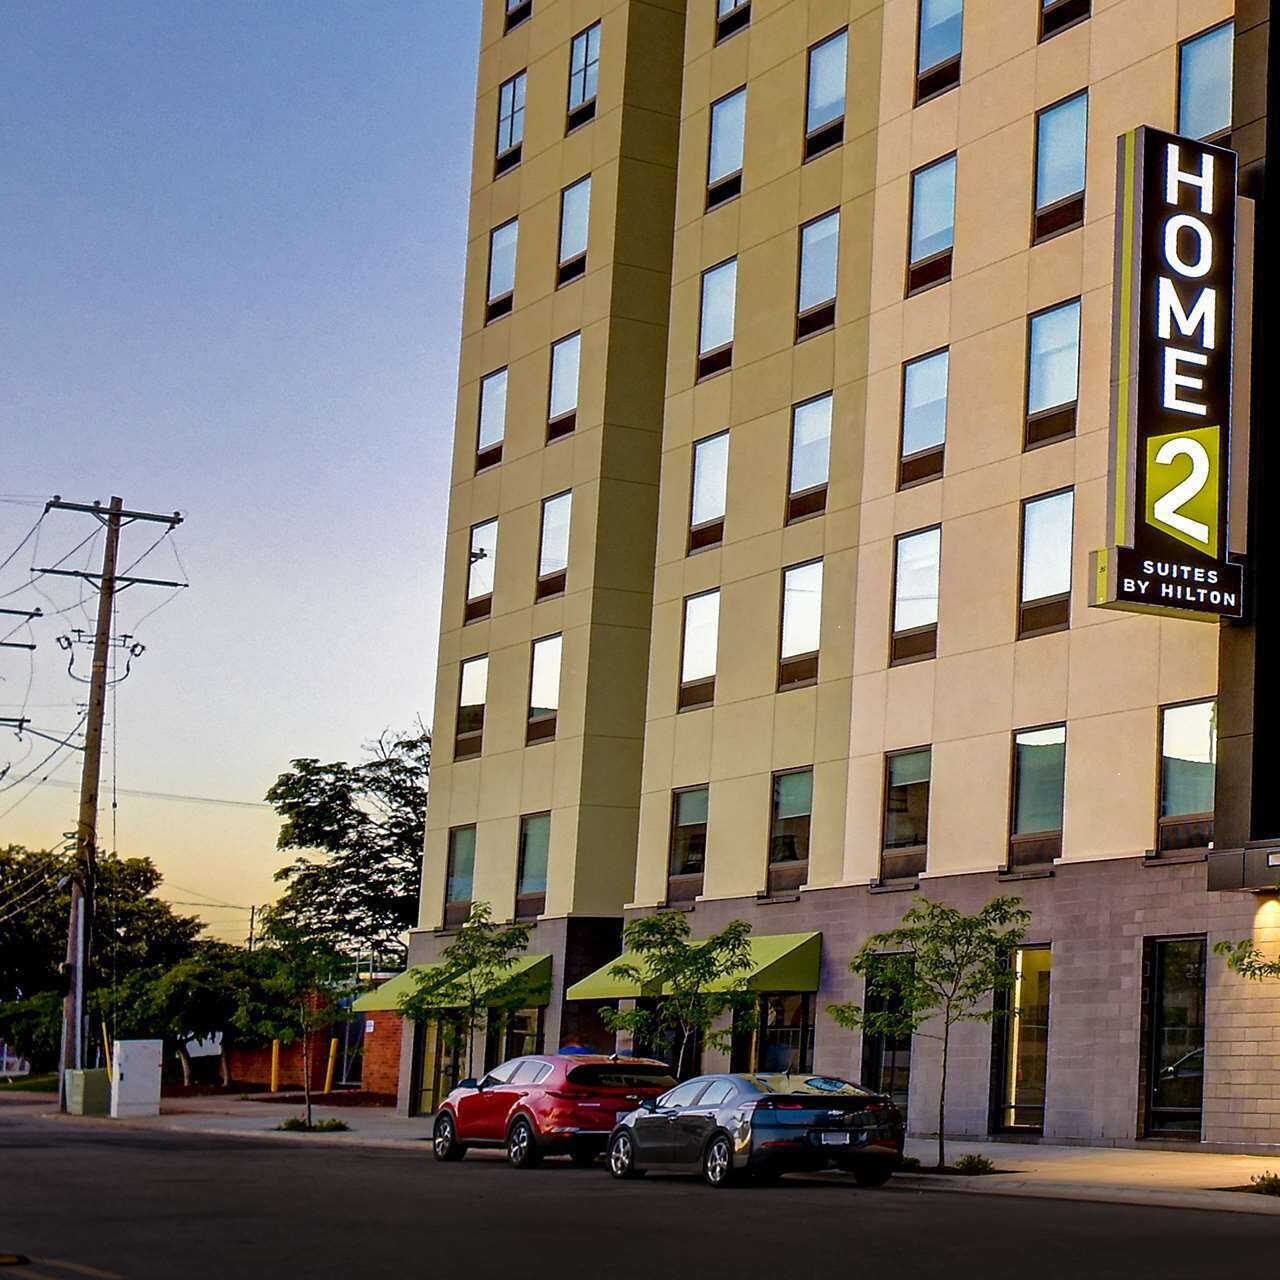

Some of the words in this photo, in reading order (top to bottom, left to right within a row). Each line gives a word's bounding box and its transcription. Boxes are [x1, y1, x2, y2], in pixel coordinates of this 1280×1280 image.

[1143, 560, 1218, 584] SUITES
[1123, 579, 1149, 594] BY
[1161, 583, 1236, 607] HILTON
